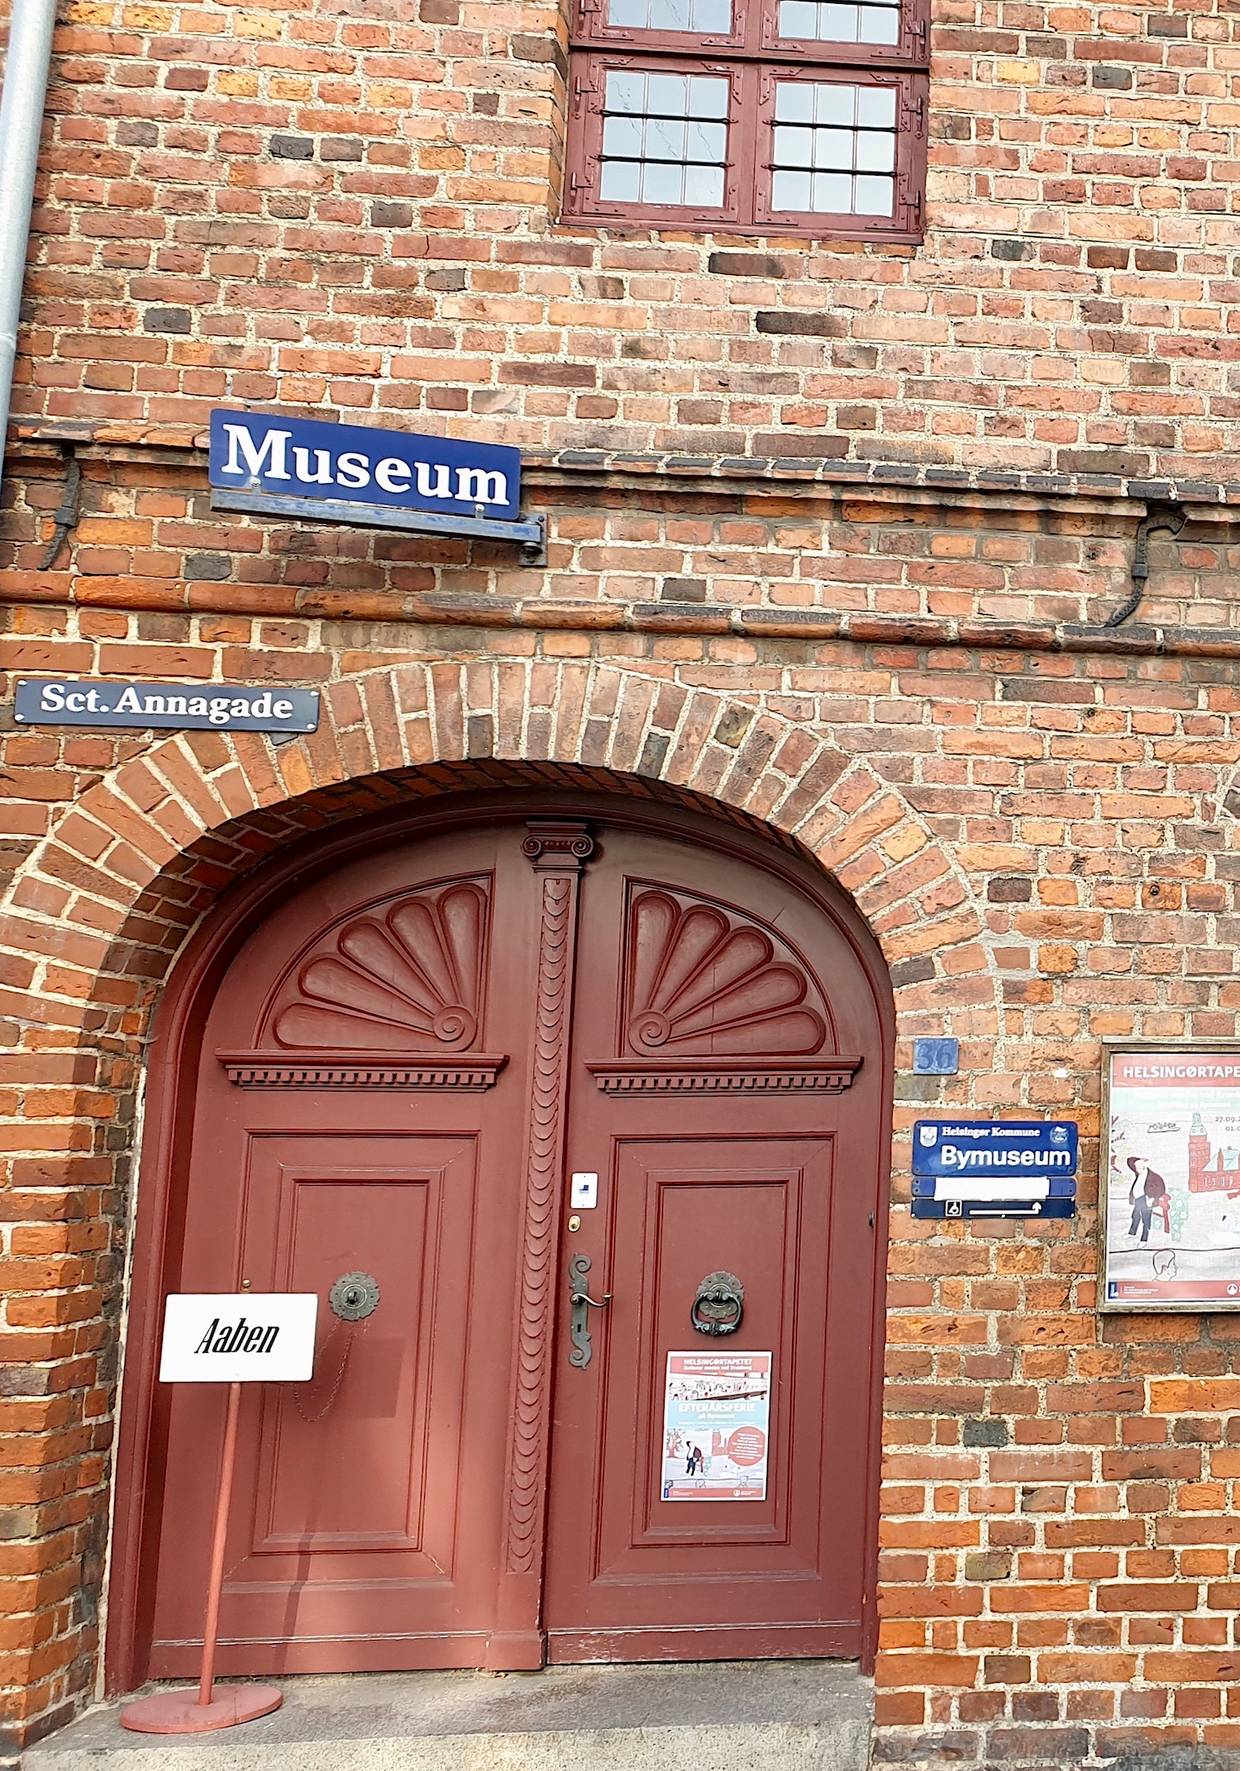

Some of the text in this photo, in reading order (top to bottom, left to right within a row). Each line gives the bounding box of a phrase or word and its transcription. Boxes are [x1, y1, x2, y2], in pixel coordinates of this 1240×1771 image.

[219, 423, 511, 508] Museum
[40, 683, 294, 725] Sct. Annagade
[916, 1042, 953, 1070] 36
[991, 1126, 1041, 1137] Kommune
[940, 1144, 1071, 1170] Bymuseum
[193, 1317, 280, 1354] Aaben
